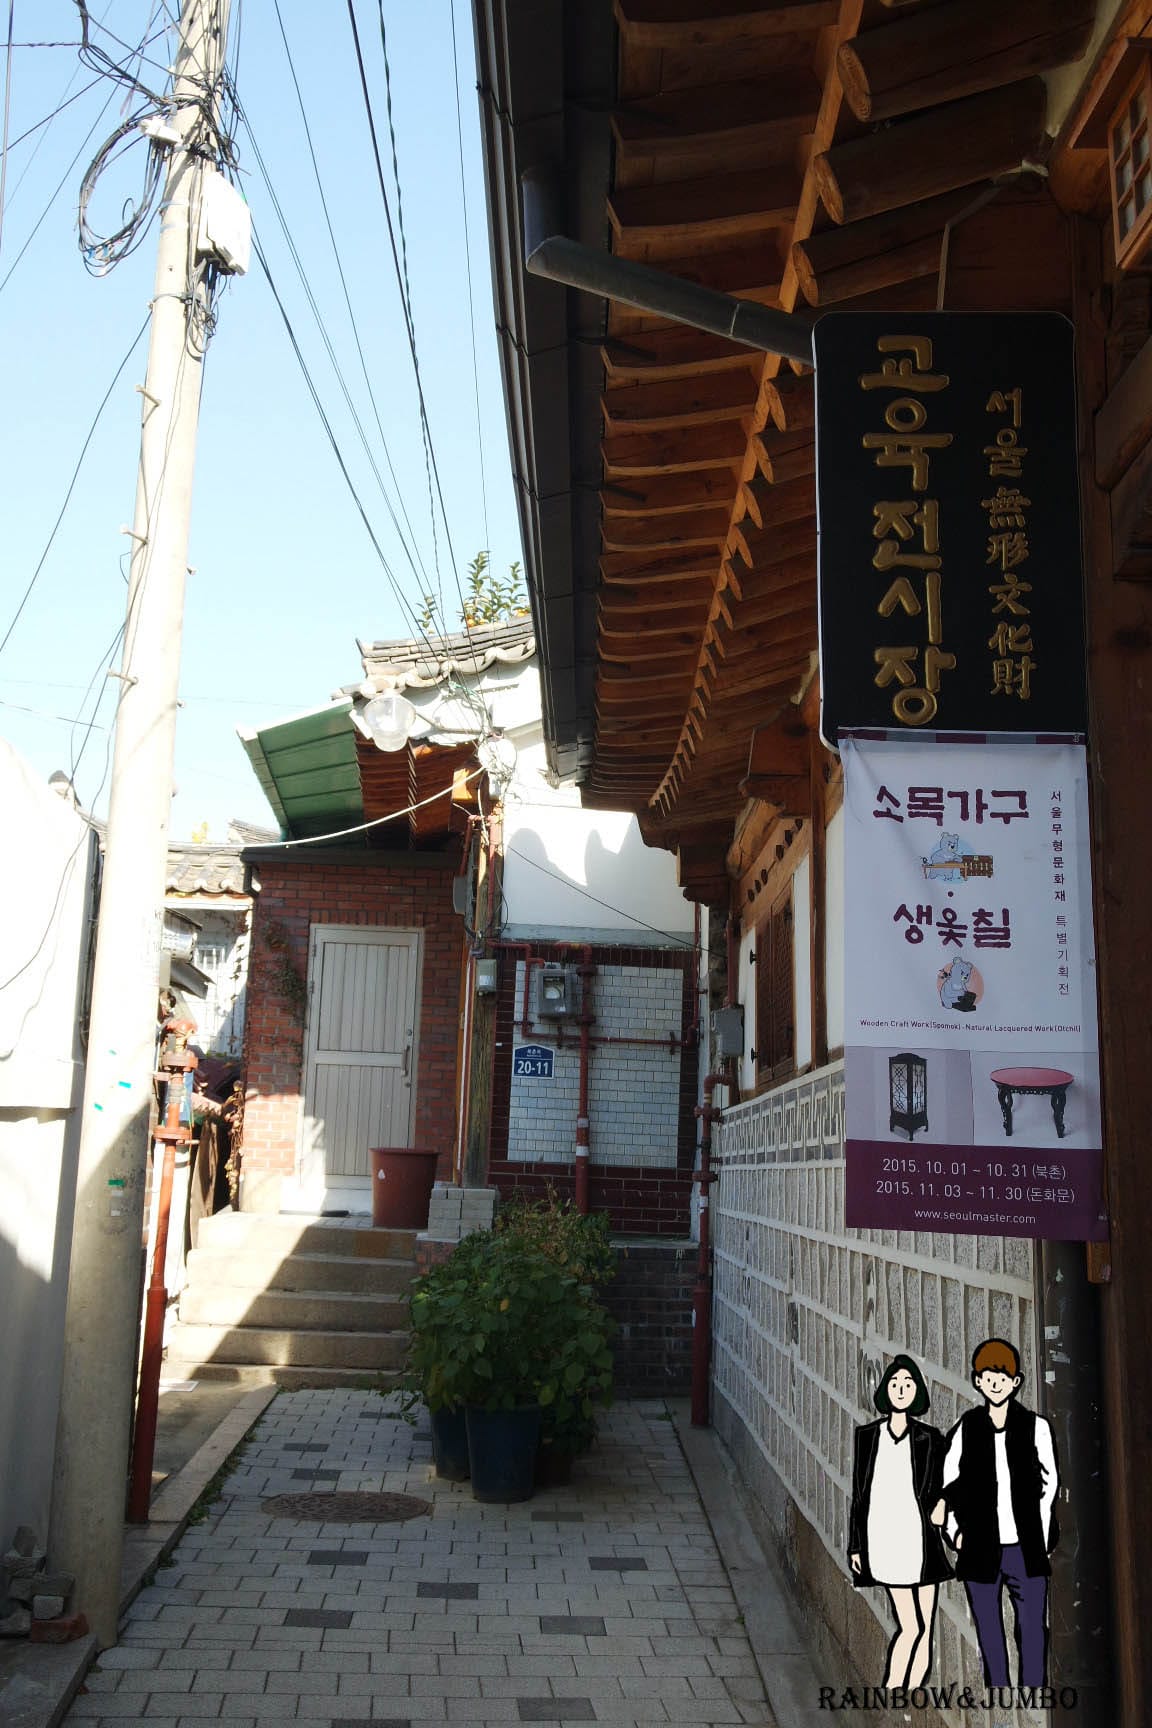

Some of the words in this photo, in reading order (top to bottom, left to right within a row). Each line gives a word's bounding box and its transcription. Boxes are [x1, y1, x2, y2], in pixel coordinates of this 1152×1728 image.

[859, 335, 957, 726] 교육전시장
[872, 785, 1030, 827] 소목가구
[893, 903, 1012, 949] 생옻칠
[860, 1019, 889, 1027] Wooden
[890, 1020, 909, 1028] Craft
[965, 1023, 992, 1031] Natural
[994, 1024, 1033, 1033] Lacquered
[517, 1060, 549, 1075] 20-11
[882, 1158, 920, 1173] 2015.
[951, 1162, 967, 1176] 01
[1011, 1164, 1027, 1178] 31
[876, 1180, 913, 1195] 2015.
[944, 1184, 961, 1198] 03
[1005, 1187, 1022, 1201] 30
[914, 1209, 1036, 1224] www.seoulmaster.com
